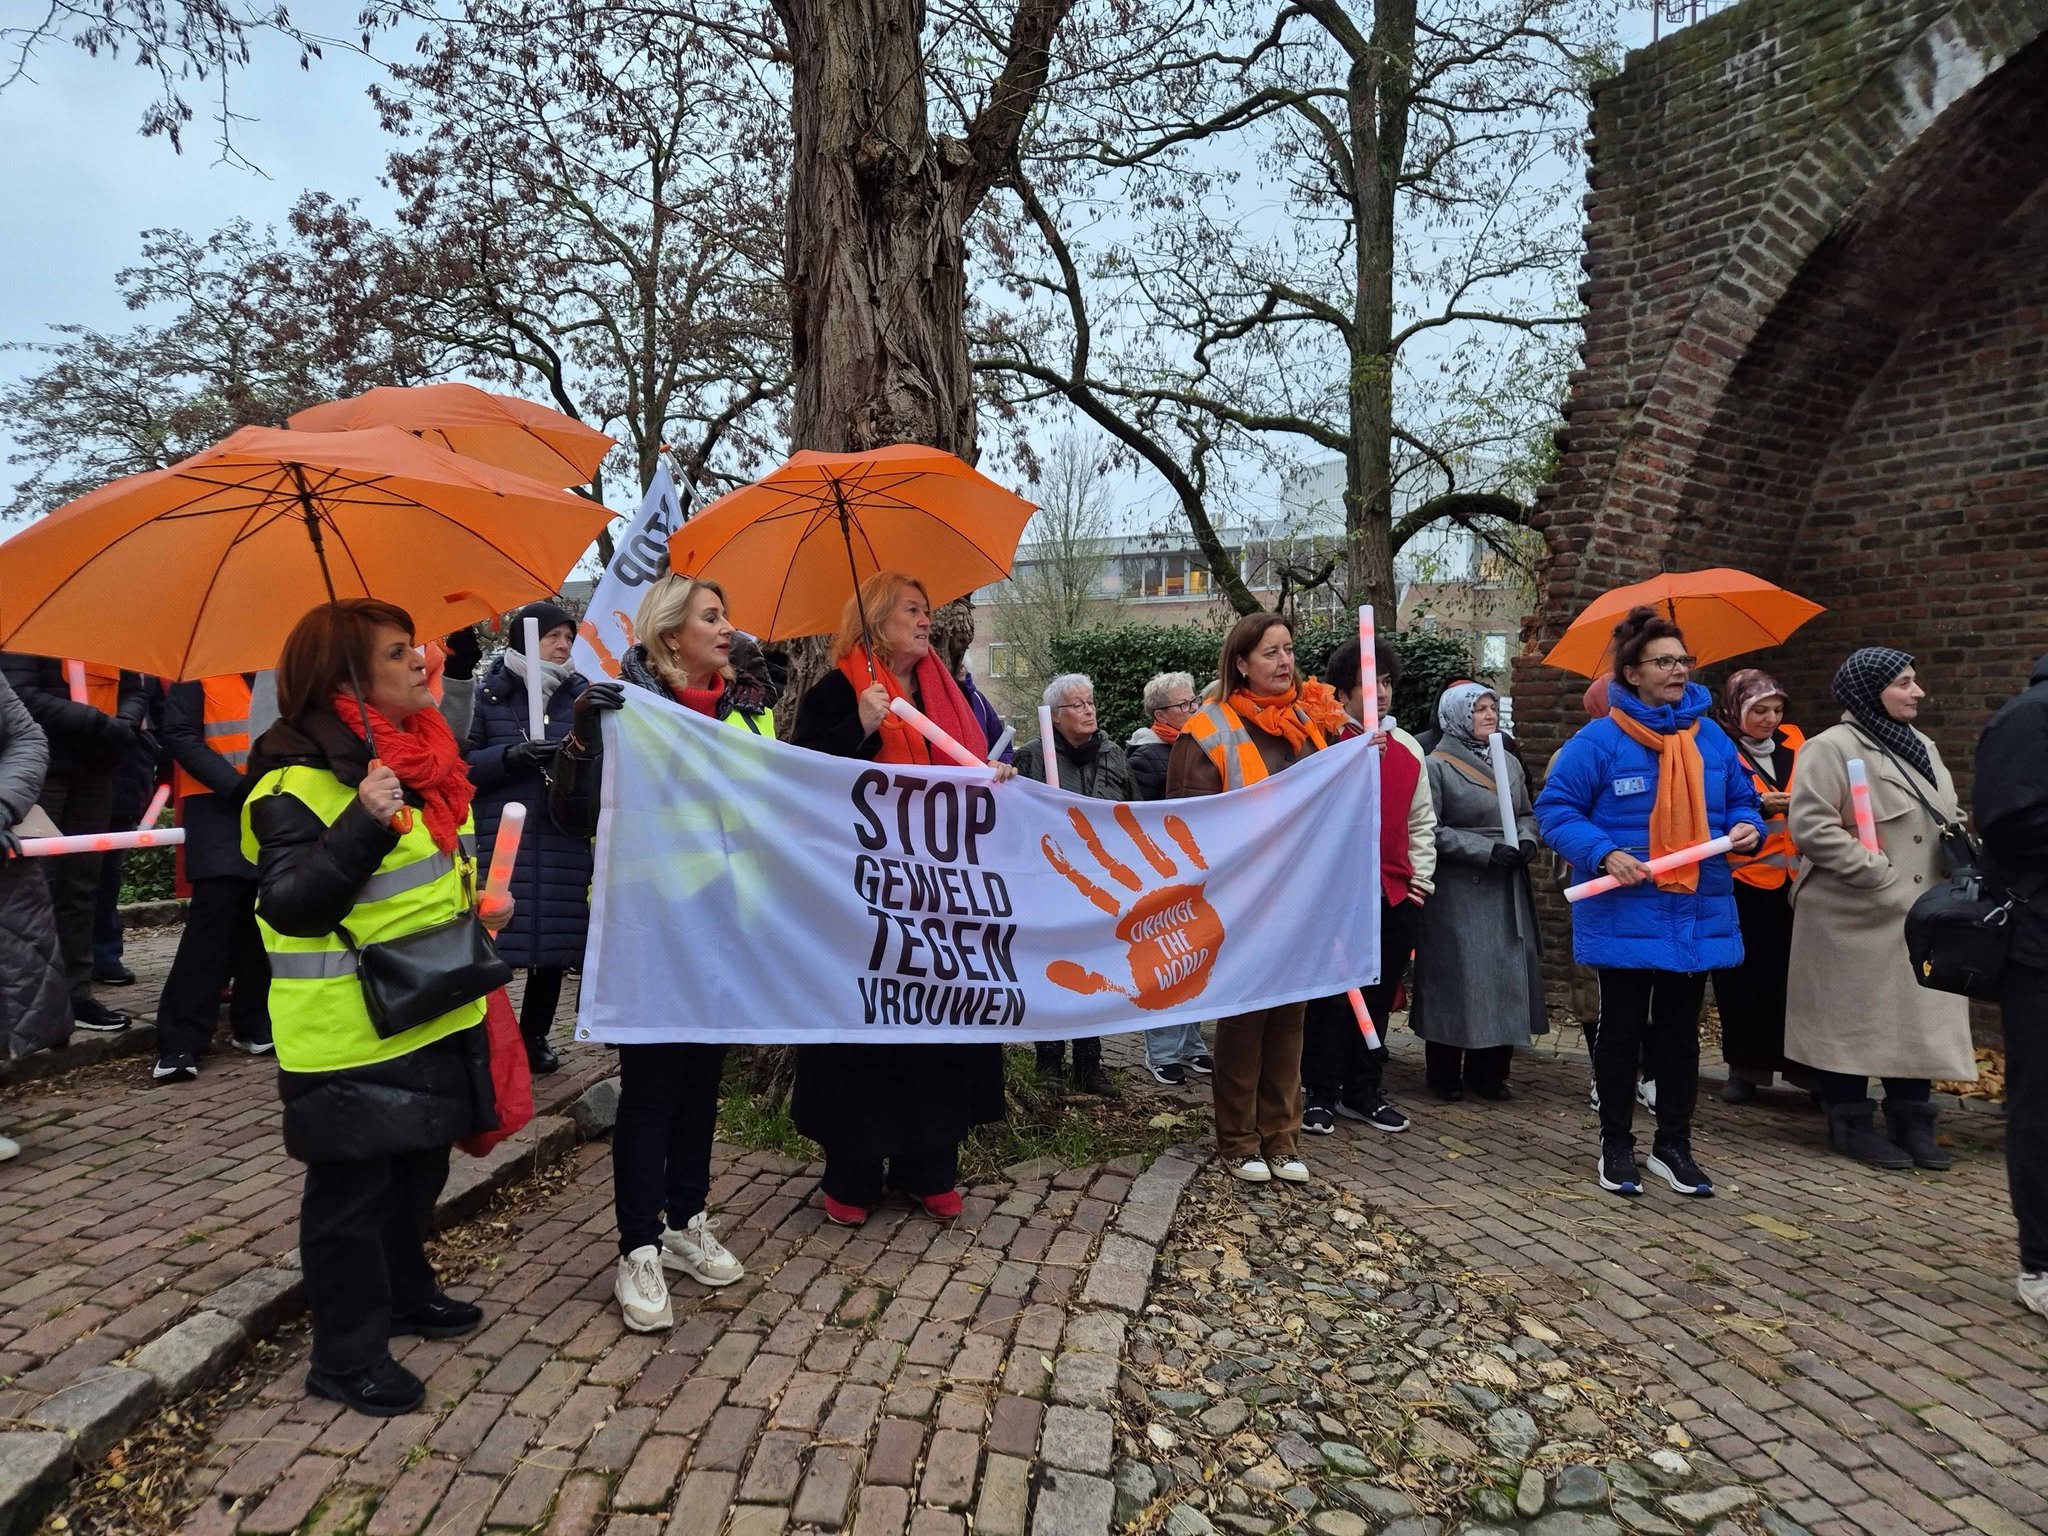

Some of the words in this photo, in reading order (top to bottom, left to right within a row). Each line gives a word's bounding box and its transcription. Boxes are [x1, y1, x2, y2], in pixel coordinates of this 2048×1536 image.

[851, 768, 996, 865] STOP
[854, 854, 1013, 918] GEWELD
[868, 906, 1018, 982] TEGEN
[1130, 898, 1199, 943] ORANGE
[1154, 928, 1194, 960] THE
[1154, 947, 1209, 992] WORLD
[857, 978, 1026, 1026] VROUWEN
